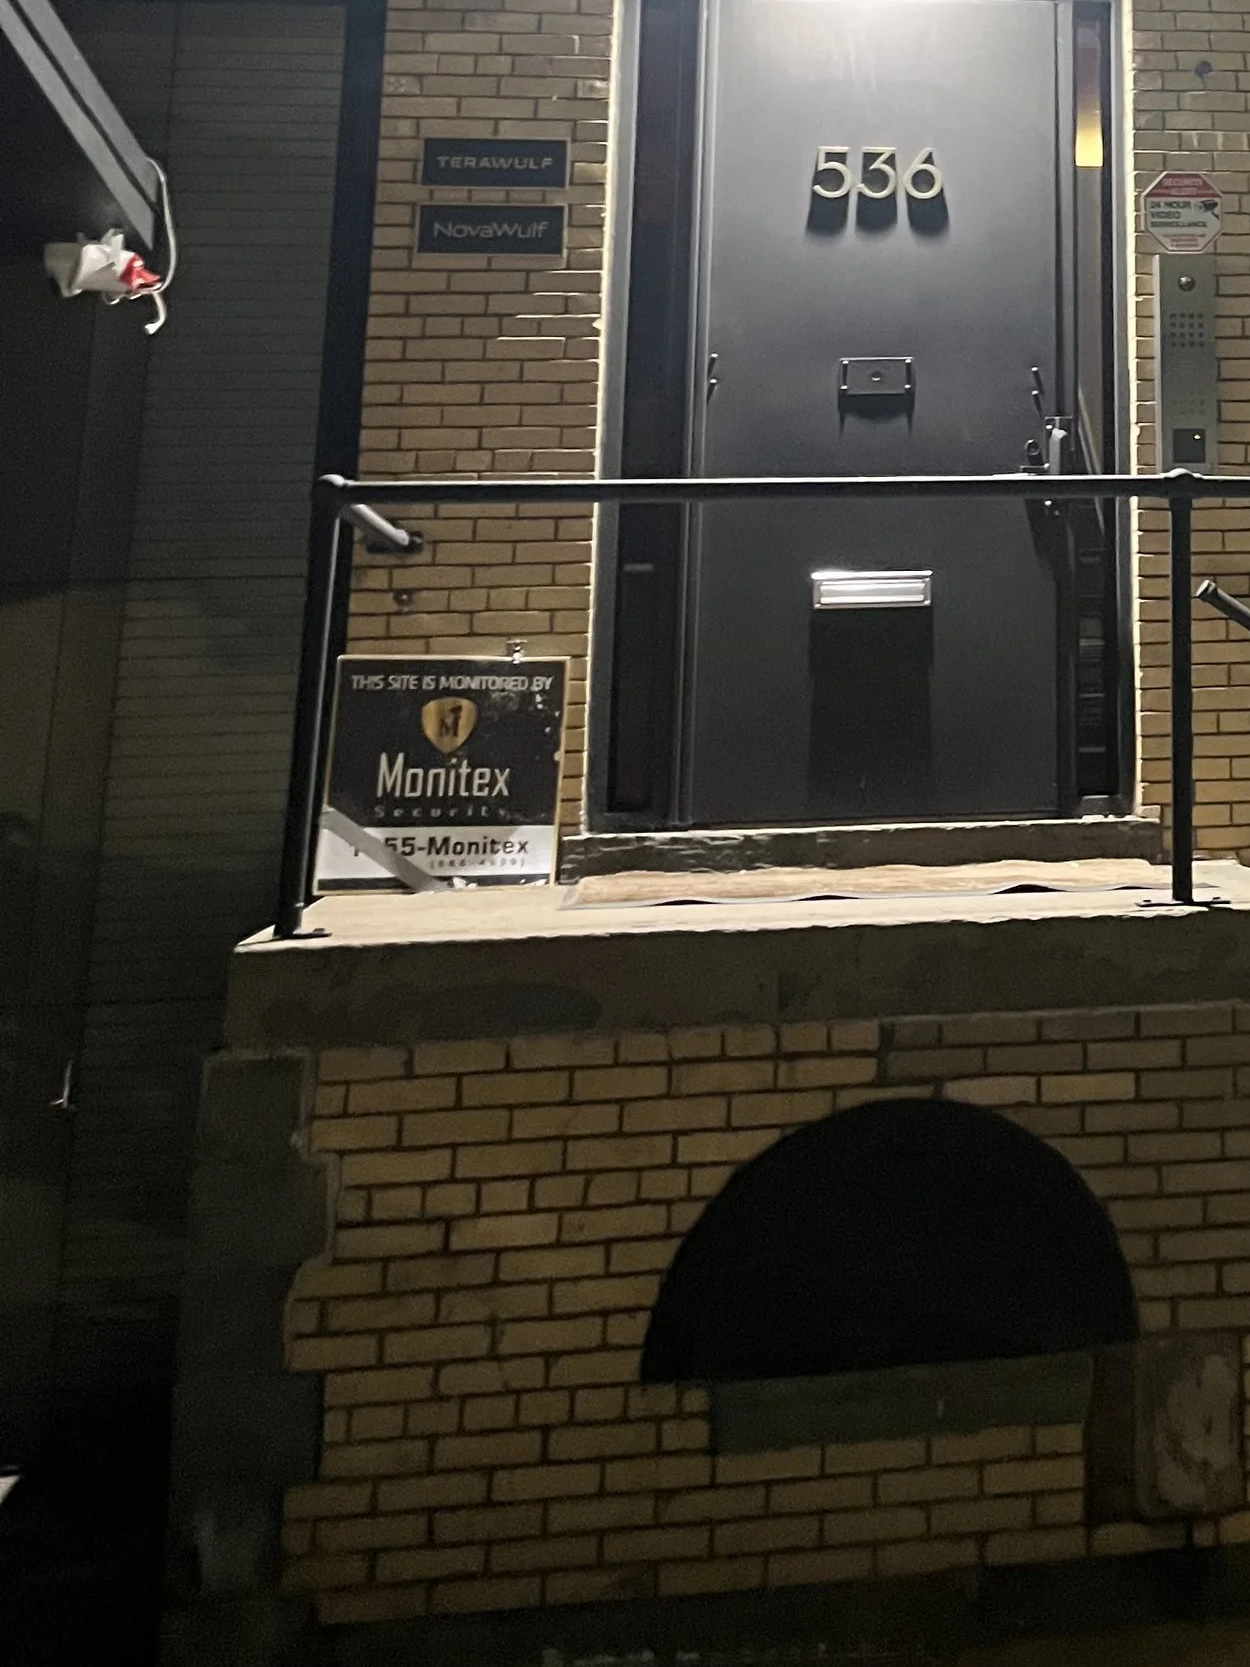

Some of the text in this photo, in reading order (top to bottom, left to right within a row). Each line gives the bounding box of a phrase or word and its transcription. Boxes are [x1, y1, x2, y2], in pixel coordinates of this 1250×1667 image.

[435, 155, 553, 170] TERAWULF
[812, 145, 943, 200] 536
[433, 221, 549, 239] NovaWulf
[351, 674, 555, 691] THIS SITE IS MONITORED BY
[376, 751, 511, 799] Monitex
